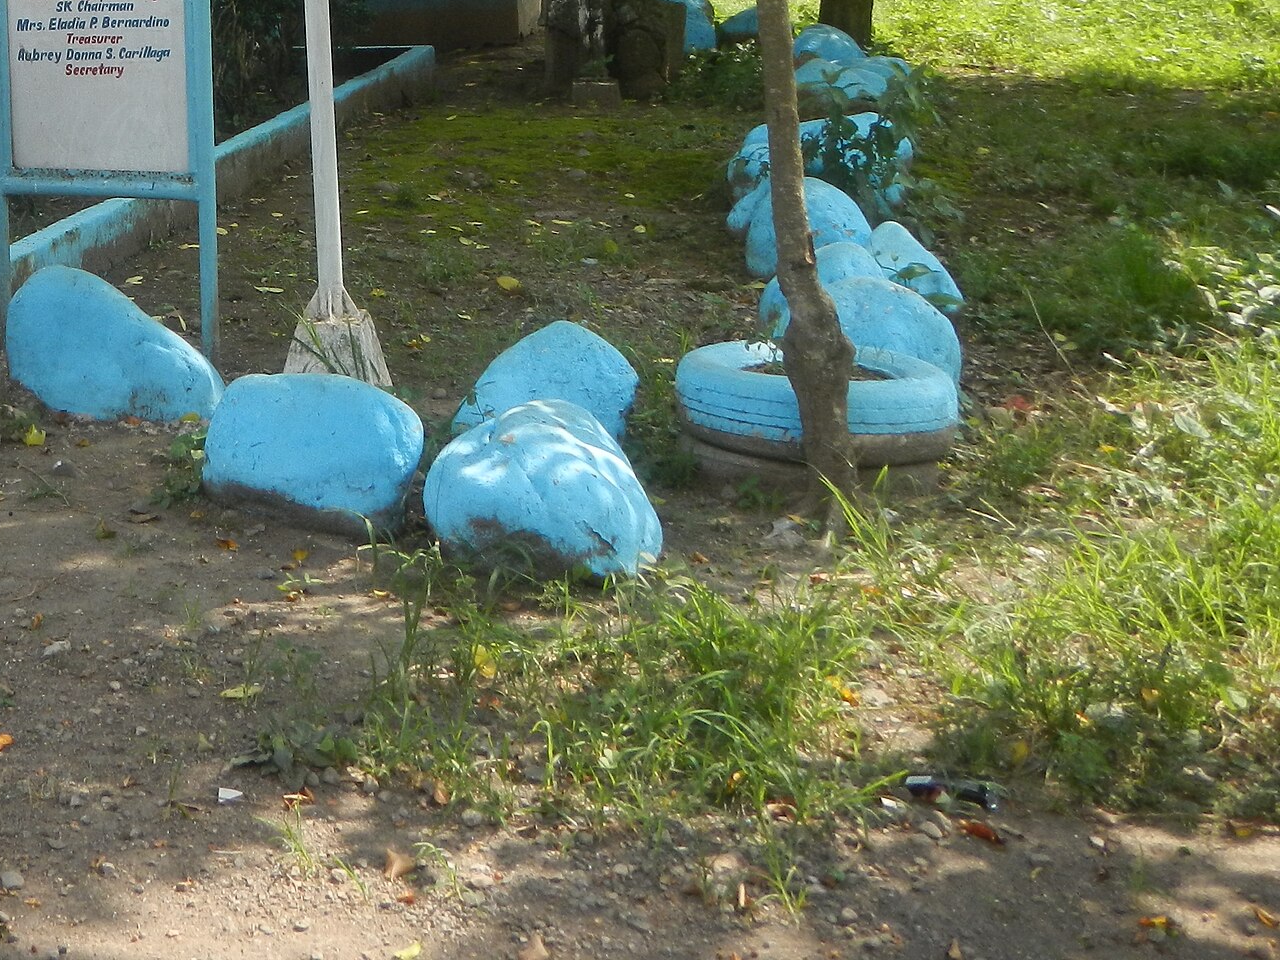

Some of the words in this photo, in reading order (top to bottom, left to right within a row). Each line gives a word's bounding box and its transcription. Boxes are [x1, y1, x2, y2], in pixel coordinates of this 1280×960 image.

[56, 1, 72, 12] SK
[78, 1, 134, 12] Chairman
[16, 19, 45, 31] Mrs.
[49, 17, 85, 30] Eladia
[90, 18, 97, 29] P.
[102, 16, 169, 29] Bernardino
[66, 34, 123, 44] Treasurer
[18, 48, 61, 63] Aubrey
[66, 48, 102, 61] Donna
[106, 47, 116, 60] S.
[119, 46, 170, 60] Carillaga
[65, 64, 124, 79] Secretary
